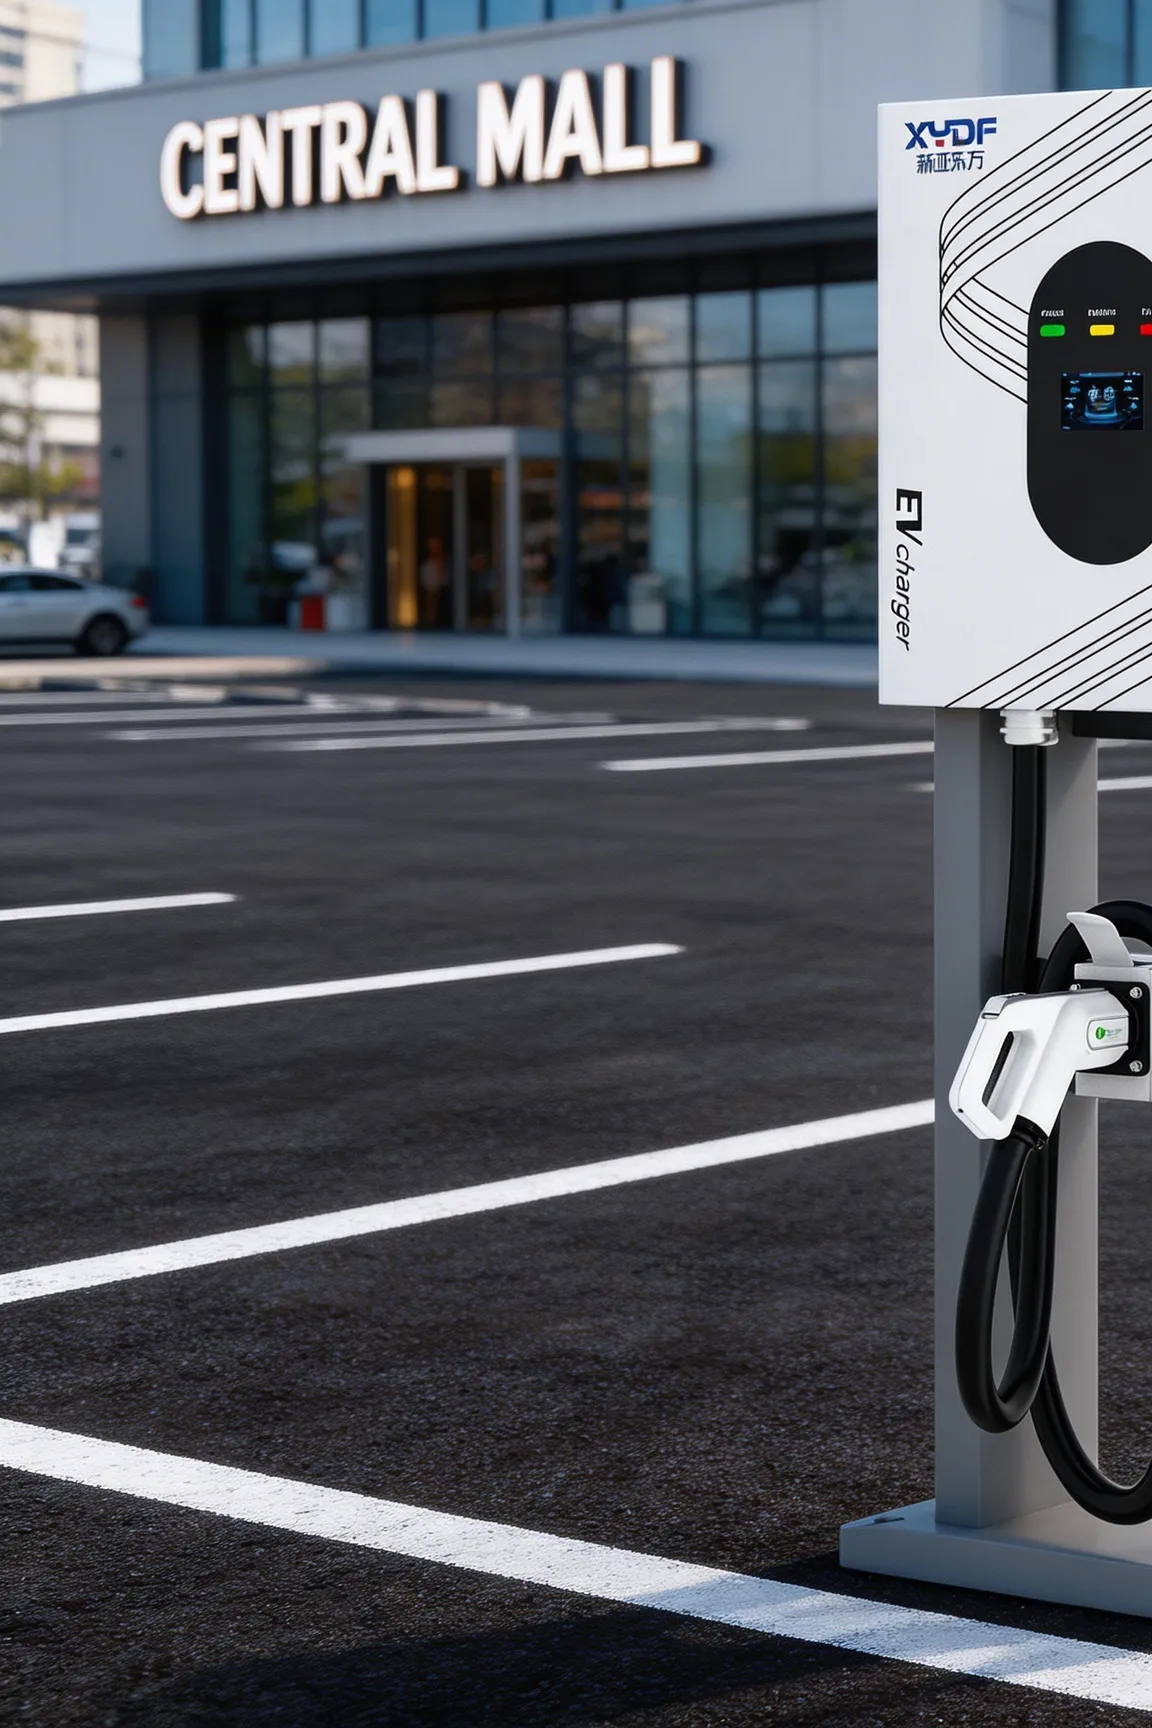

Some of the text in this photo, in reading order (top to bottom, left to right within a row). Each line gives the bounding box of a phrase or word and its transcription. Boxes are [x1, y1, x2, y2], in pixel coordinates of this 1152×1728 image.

[160, 56, 702, 220] CENTRAL MALL
[904, 117, 998, 150] XYDF
[891, 488, 923, 652] EV charger
